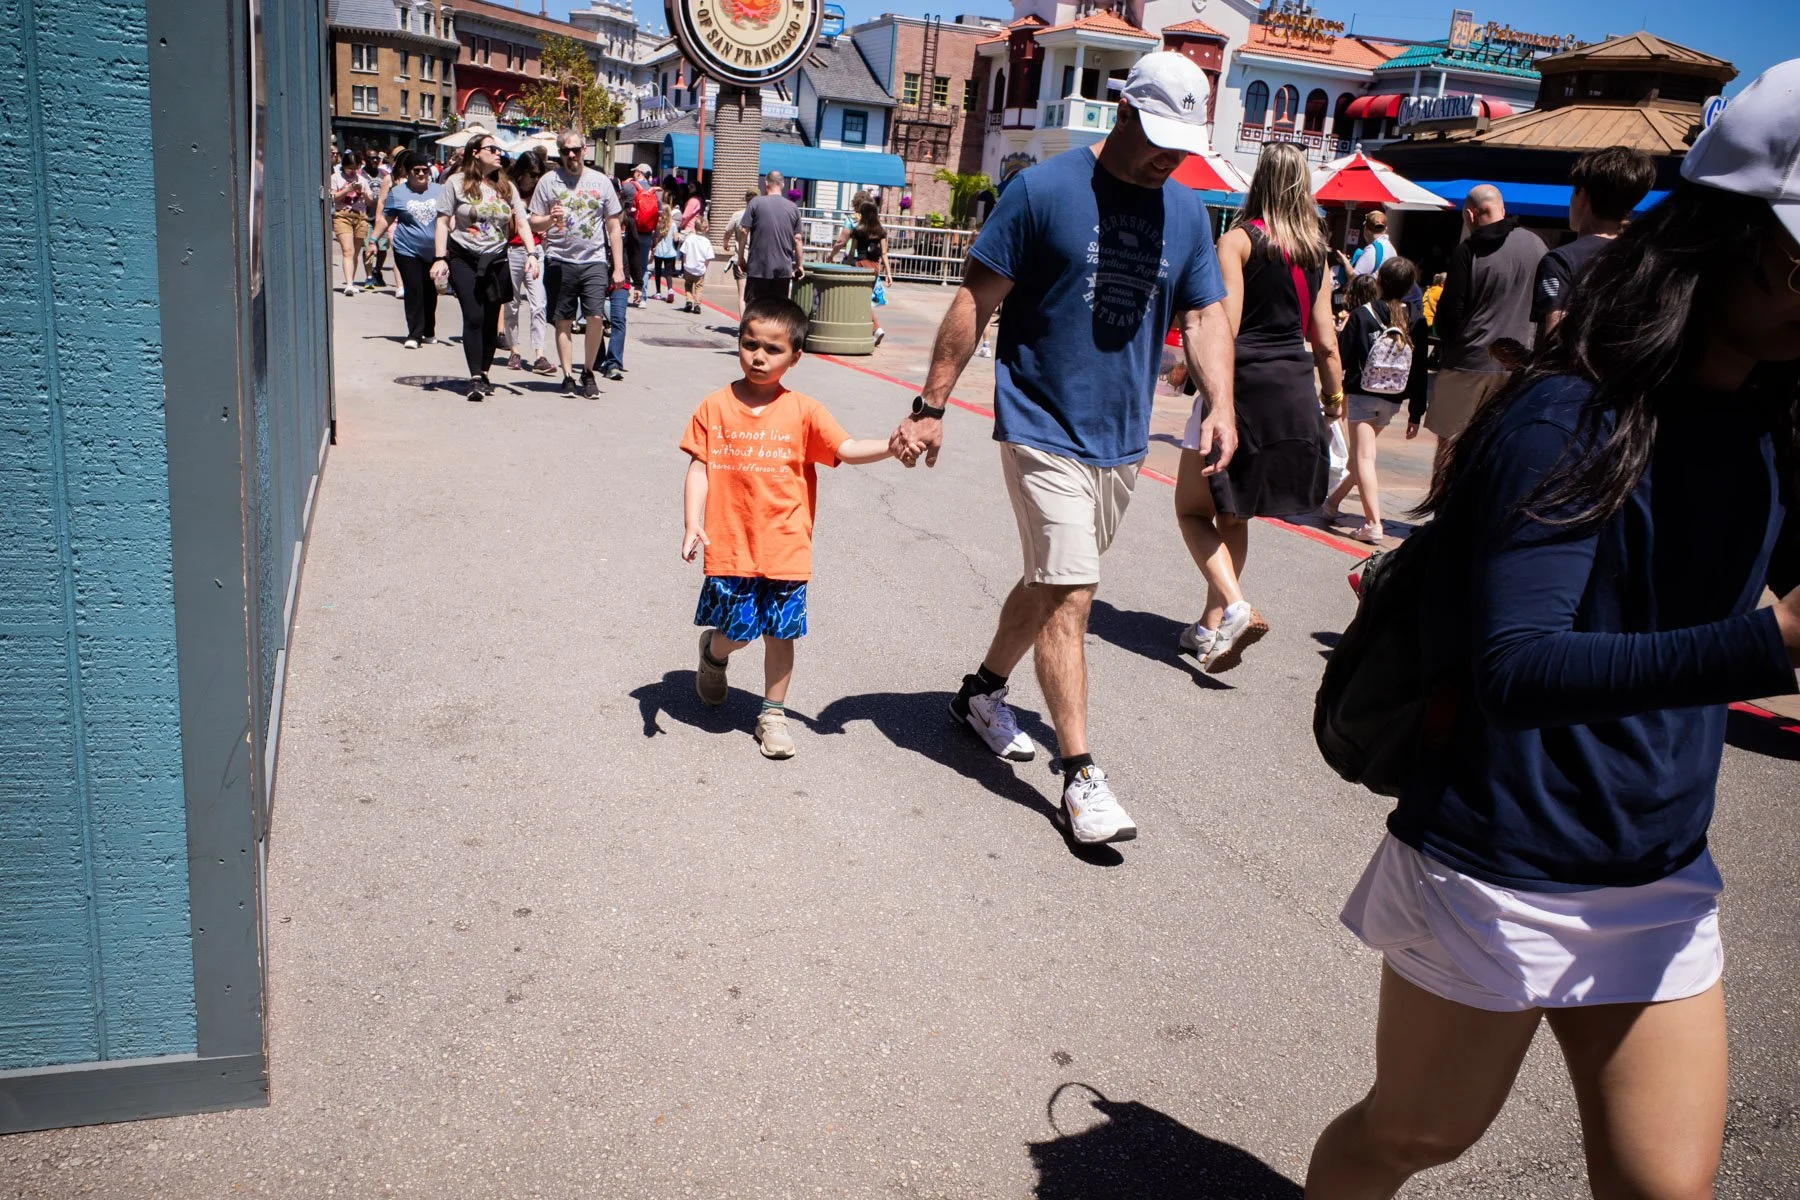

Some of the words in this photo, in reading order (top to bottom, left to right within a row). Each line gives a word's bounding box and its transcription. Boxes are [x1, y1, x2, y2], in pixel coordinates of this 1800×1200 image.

[697, 9, 713, 28] OF
[706, 28, 734, 59] SAN
[734, 20, 802, 66] FRANCISCO
[1420, 95, 1475, 119] ALCATRAZ
[1093, 213, 1166, 249] BERKSHIRE
[1086, 253, 1129, 271] Together
[1135, 264, 1169, 279] Again
[1087, 241, 1170, 268] Shareholders
[724, 429, 767, 441] cannot
[770, 429, 791, 442] live
[710, 444, 753, 457] without
